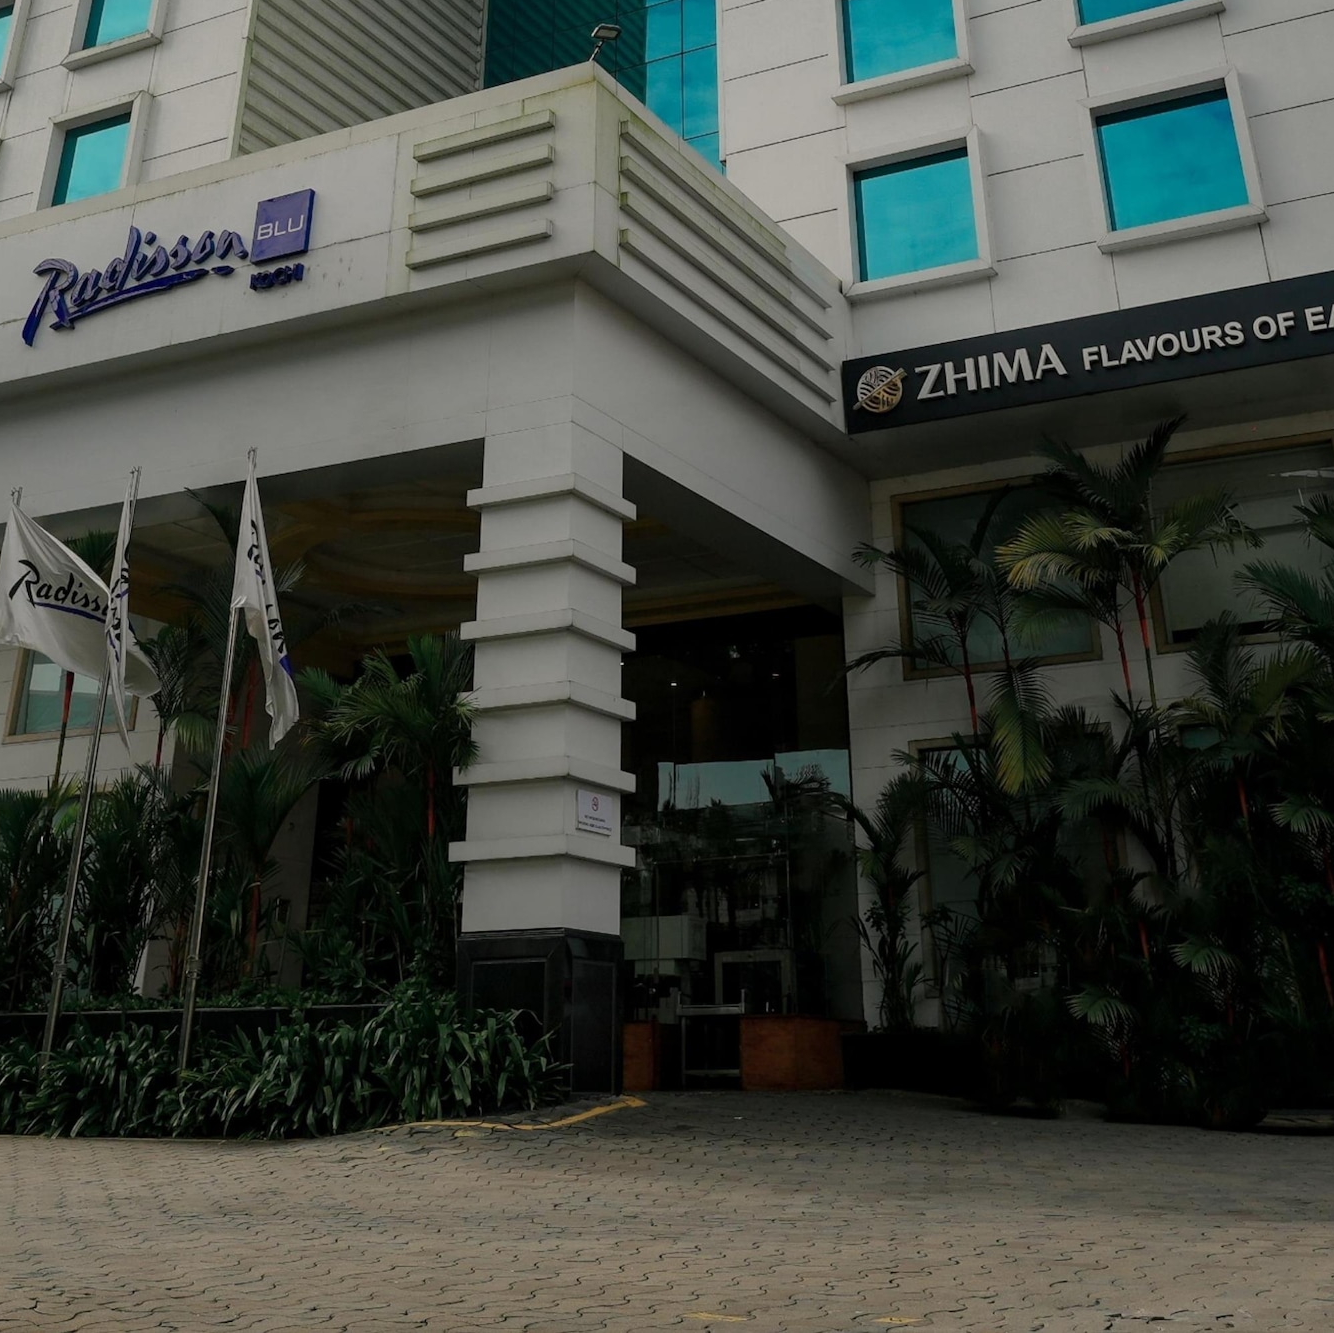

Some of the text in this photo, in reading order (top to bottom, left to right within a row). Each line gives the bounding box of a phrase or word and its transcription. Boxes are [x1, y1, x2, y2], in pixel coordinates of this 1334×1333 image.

[22, 214, 304, 347] Radisson BLU
[915, 343, 1068, 401] ZHIMA
[1082, 321, 1246, 372] FLAVOURS
[1252, 311, 1296, 341] OF
[8, 559, 109, 616] Radiss
